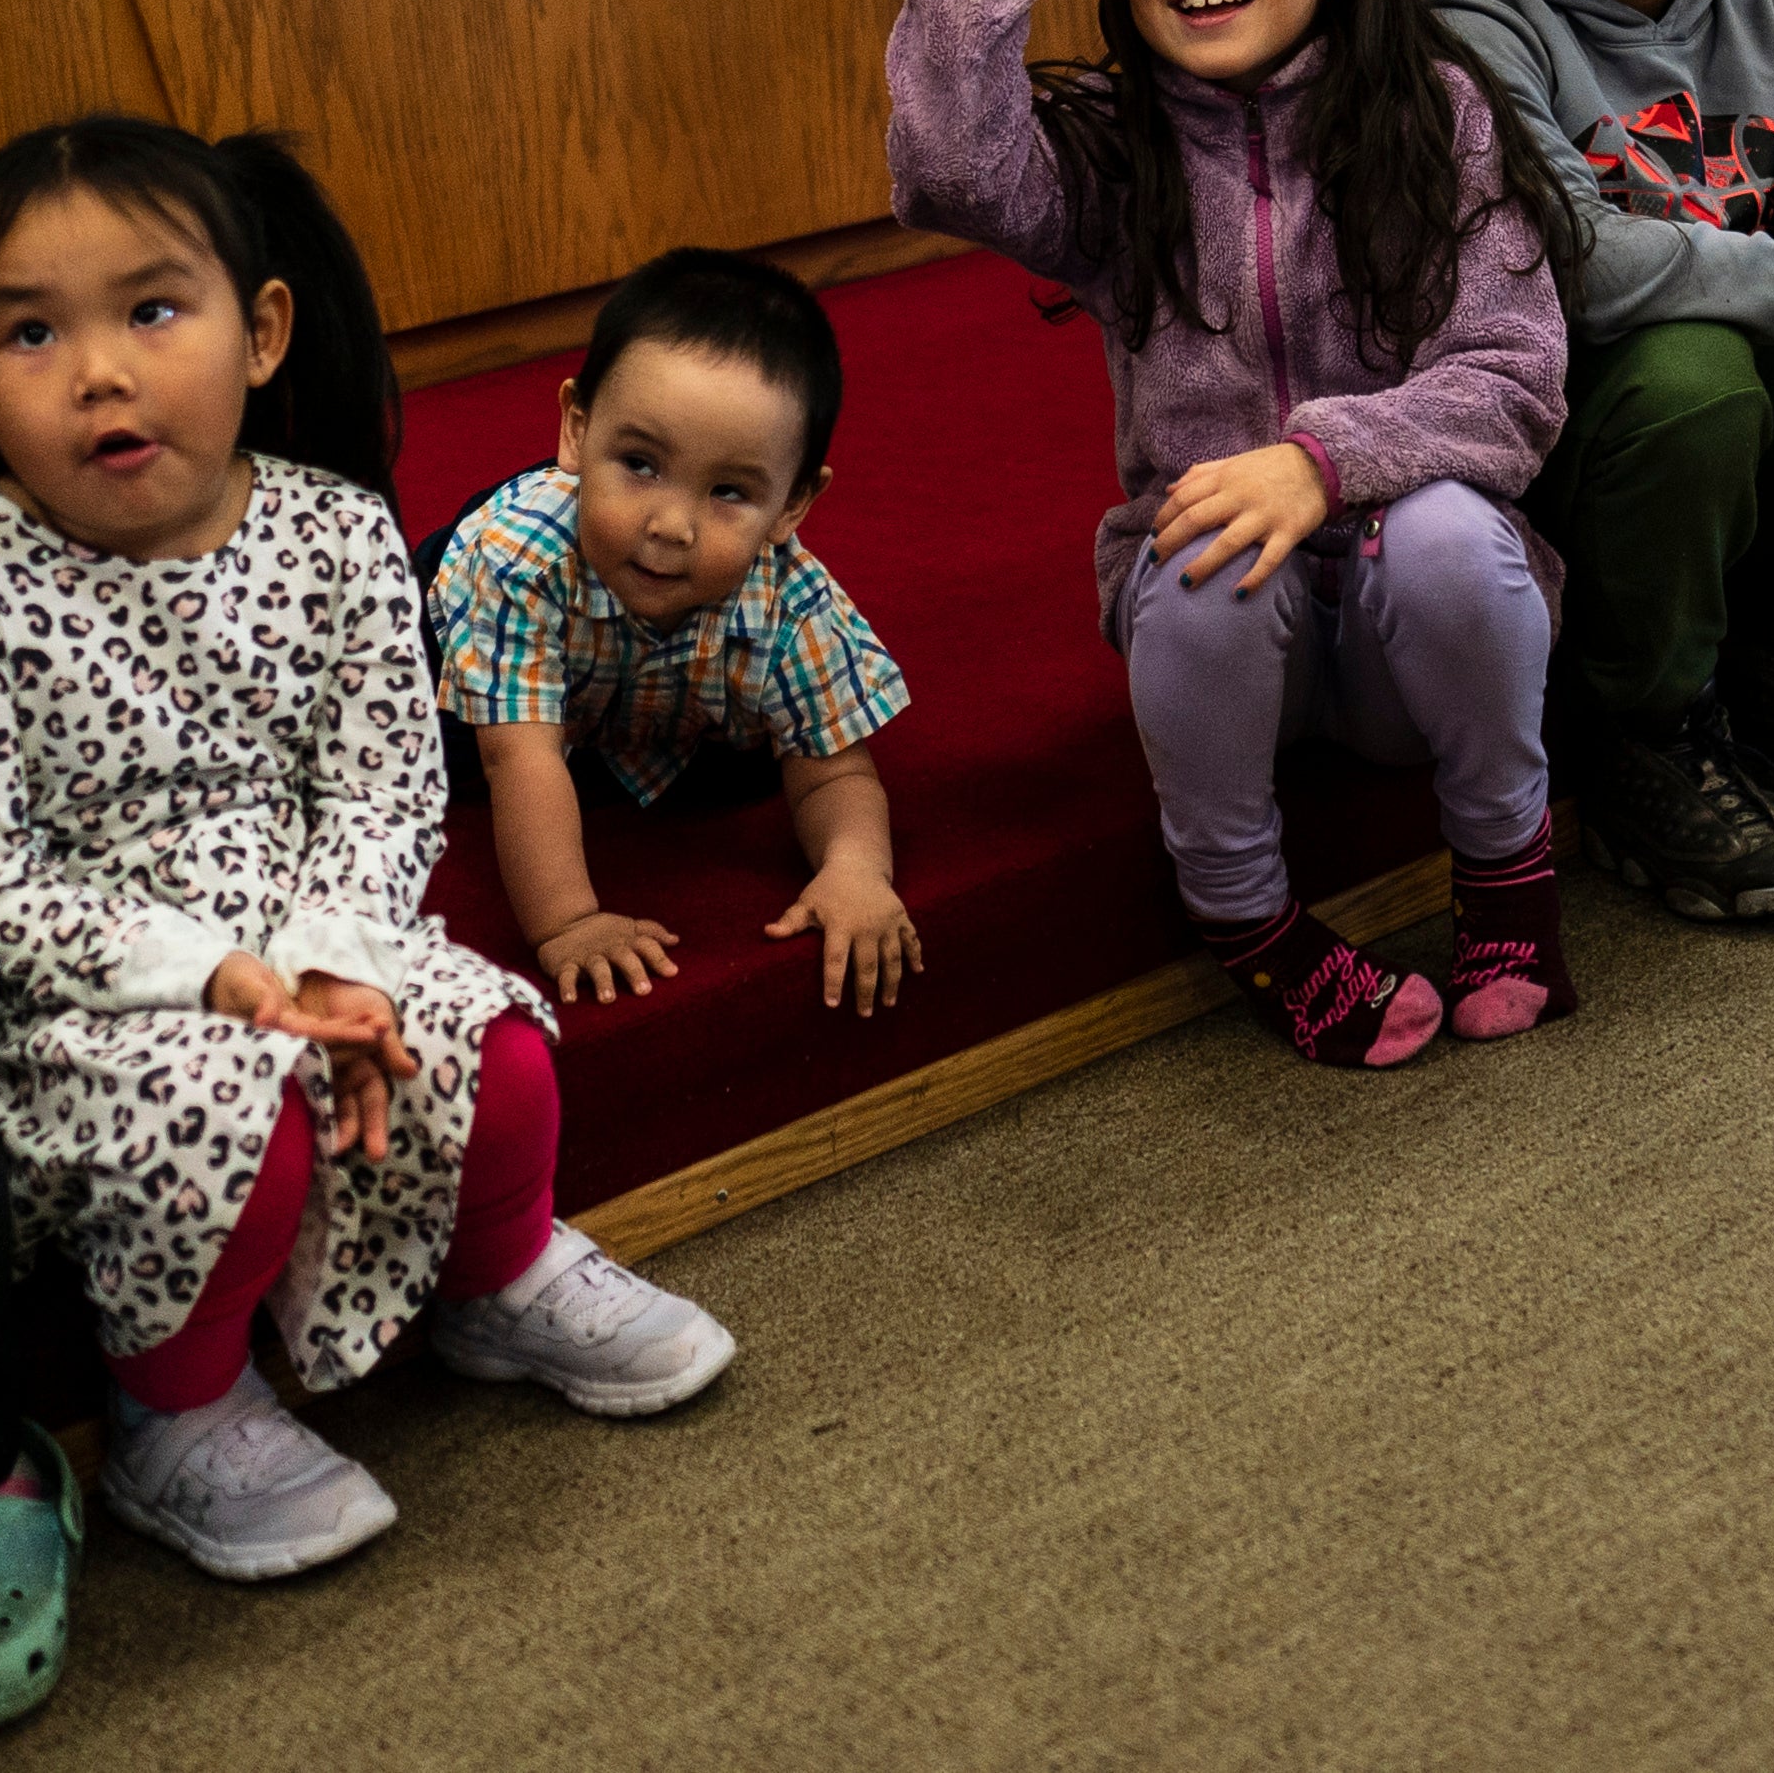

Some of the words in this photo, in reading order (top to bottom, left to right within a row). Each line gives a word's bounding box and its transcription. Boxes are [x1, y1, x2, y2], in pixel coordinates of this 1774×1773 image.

[1284, 944, 1358, 1022] Sunny
[1455, 933, 1538, 967] Sunny
[1295, 964, 1381, 1058] Sunday
